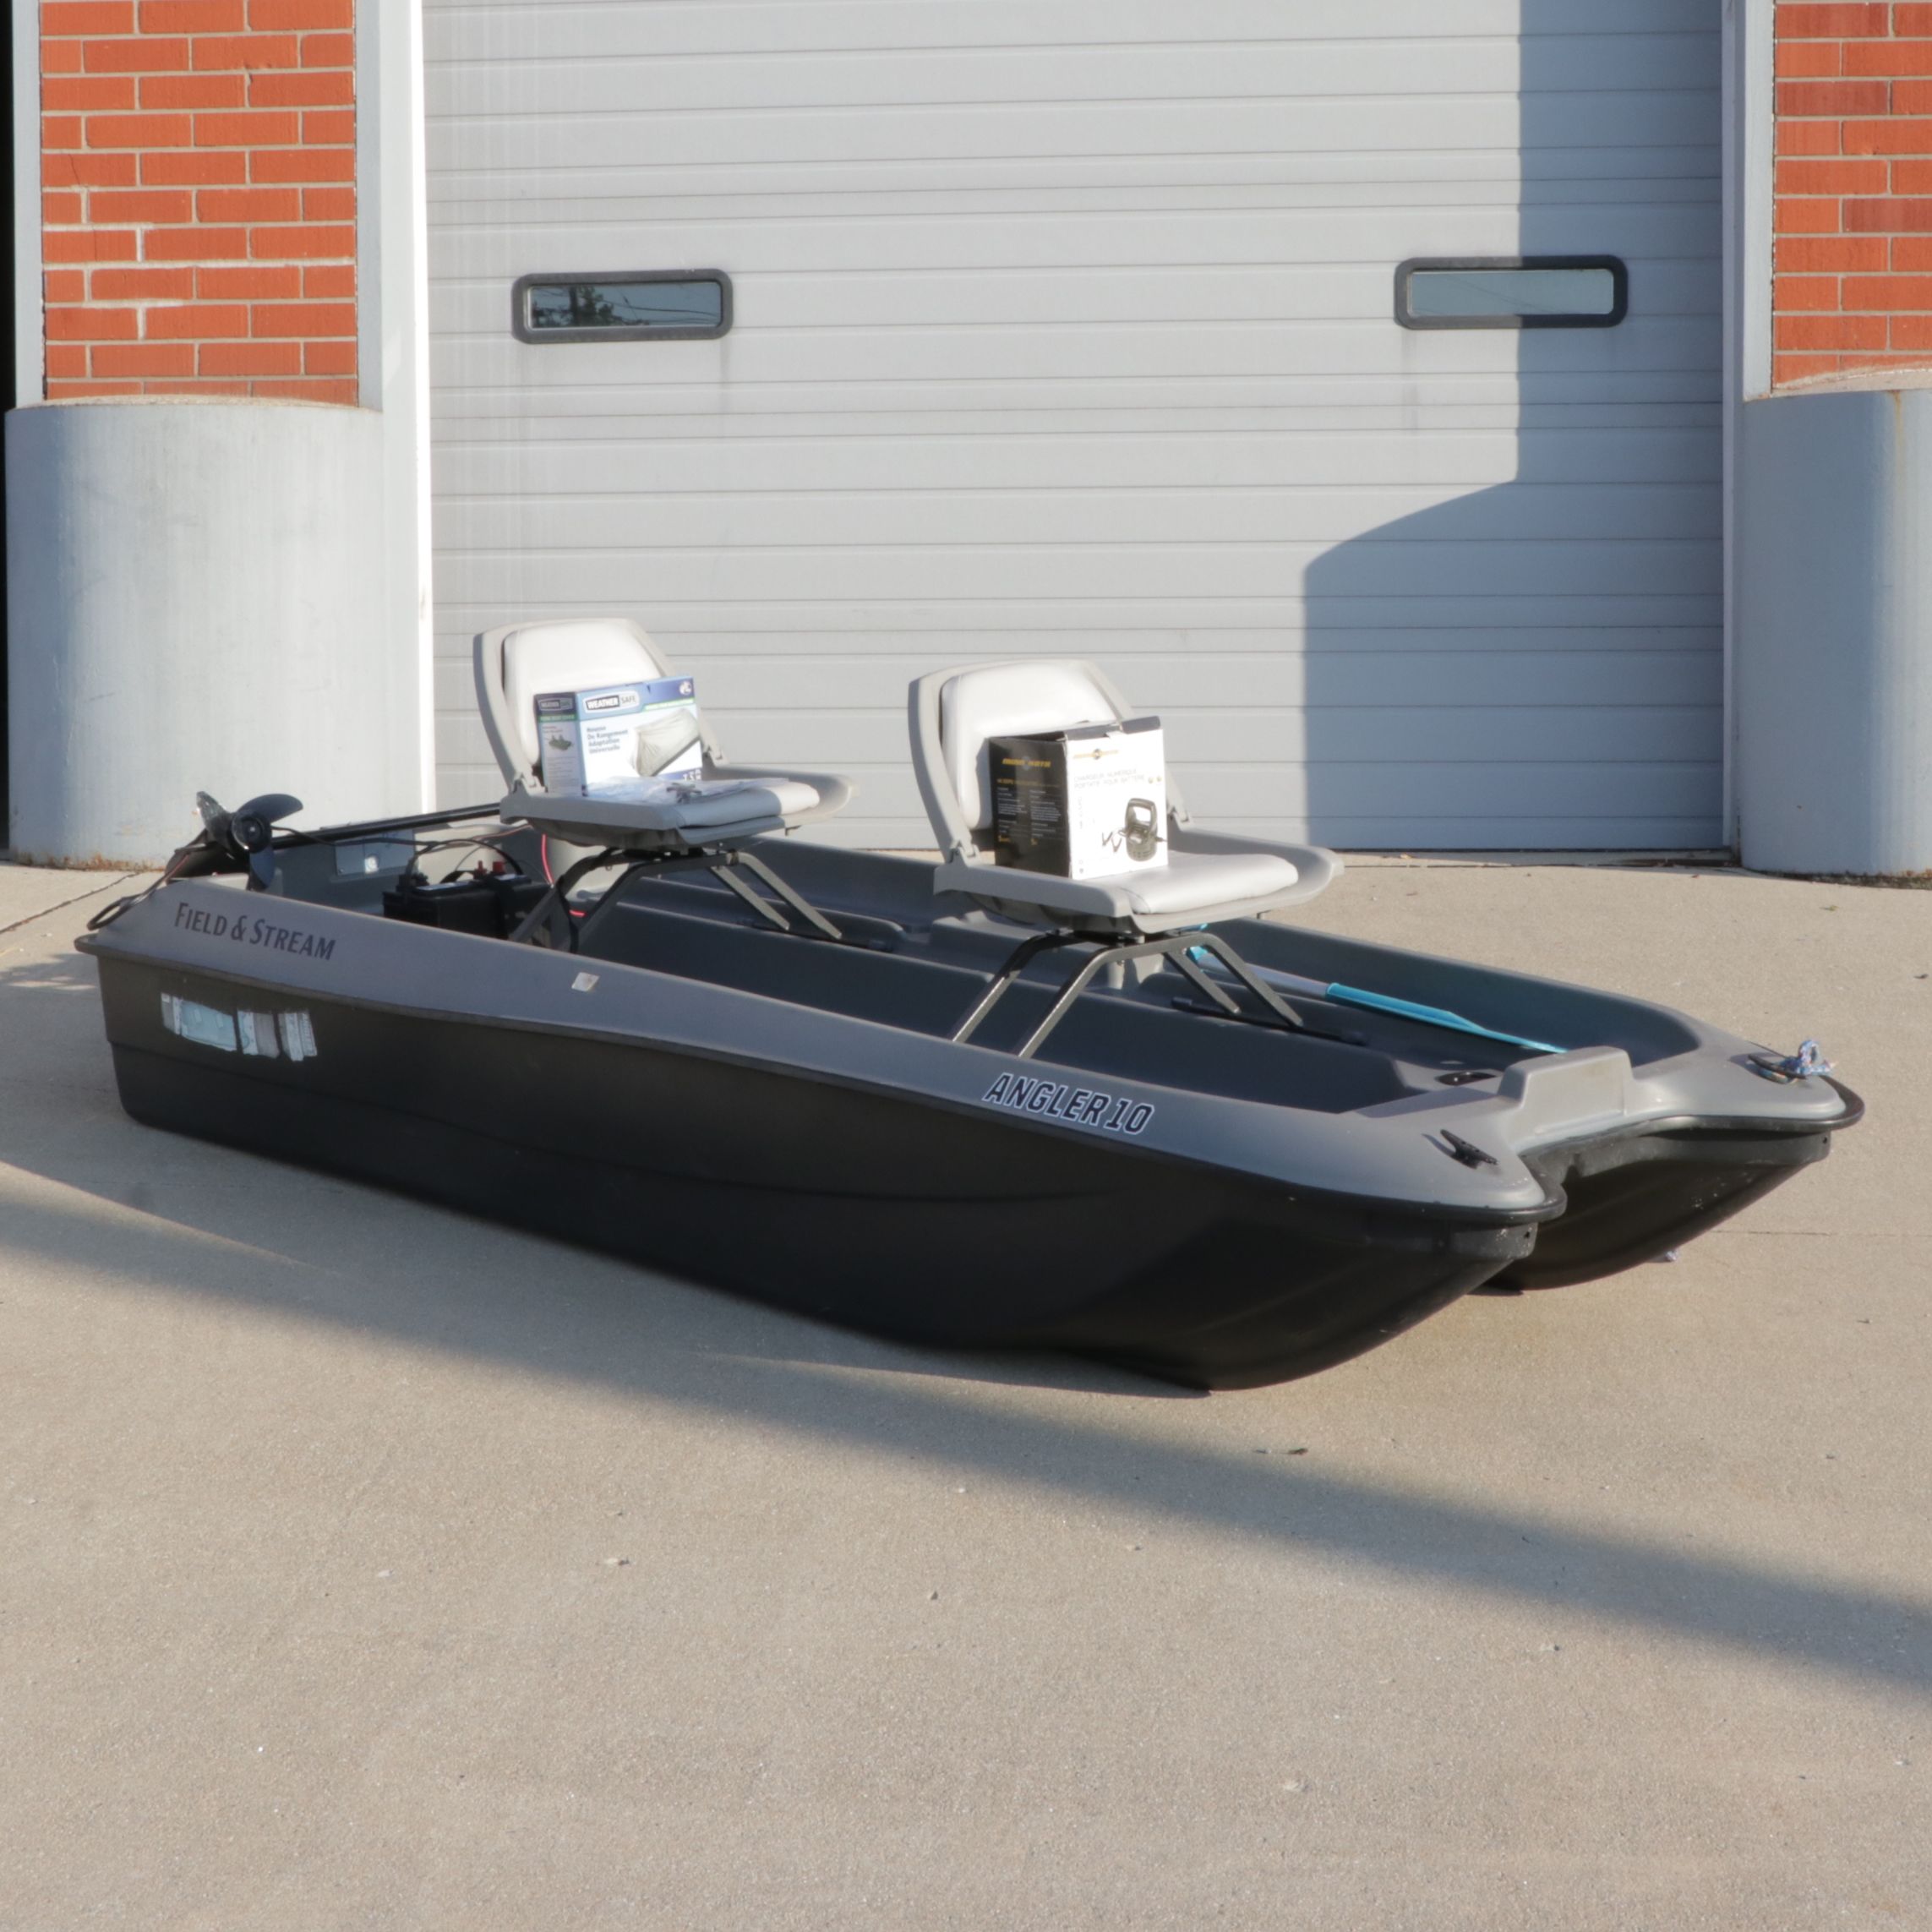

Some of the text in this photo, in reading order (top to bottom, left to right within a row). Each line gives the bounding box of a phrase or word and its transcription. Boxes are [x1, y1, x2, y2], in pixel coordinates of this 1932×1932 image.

[587, 696, 636, 709] WEATHER SAFE
[597, 729, 629, 739] Rangement
[588, 738, 620, 747] Adaptation
[174, 903, 336, 960] FIELD & STREAM
[982, 1072, 1154, 1135] ANGLER 10
